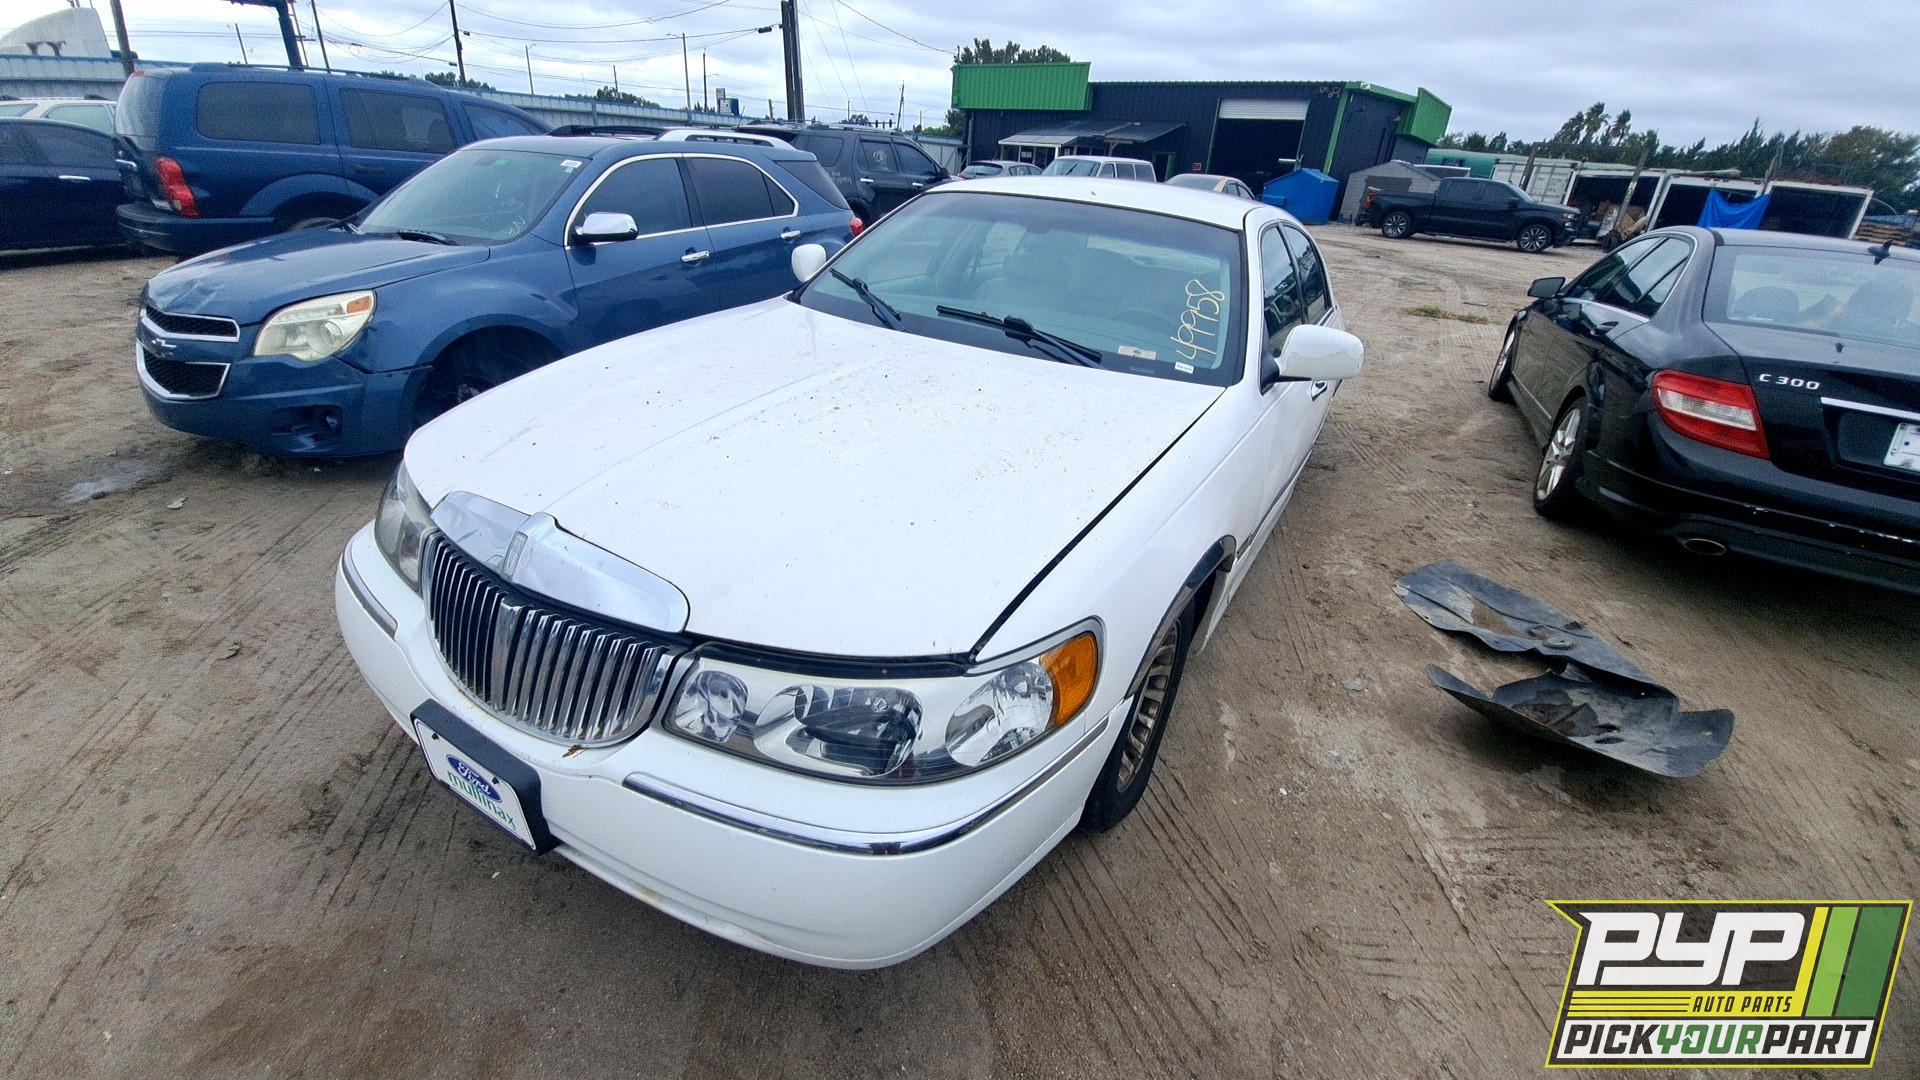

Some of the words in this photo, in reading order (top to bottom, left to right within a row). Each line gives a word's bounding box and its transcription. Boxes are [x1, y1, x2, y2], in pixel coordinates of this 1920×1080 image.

[1170, 279, 1225, 360] 49958
[1758, 373, 1772, 383] C
[1775, 376, 1820, 390] 300
[446, 770, 517, 830] mullinax
[457, 762, 491, 795] Ford
